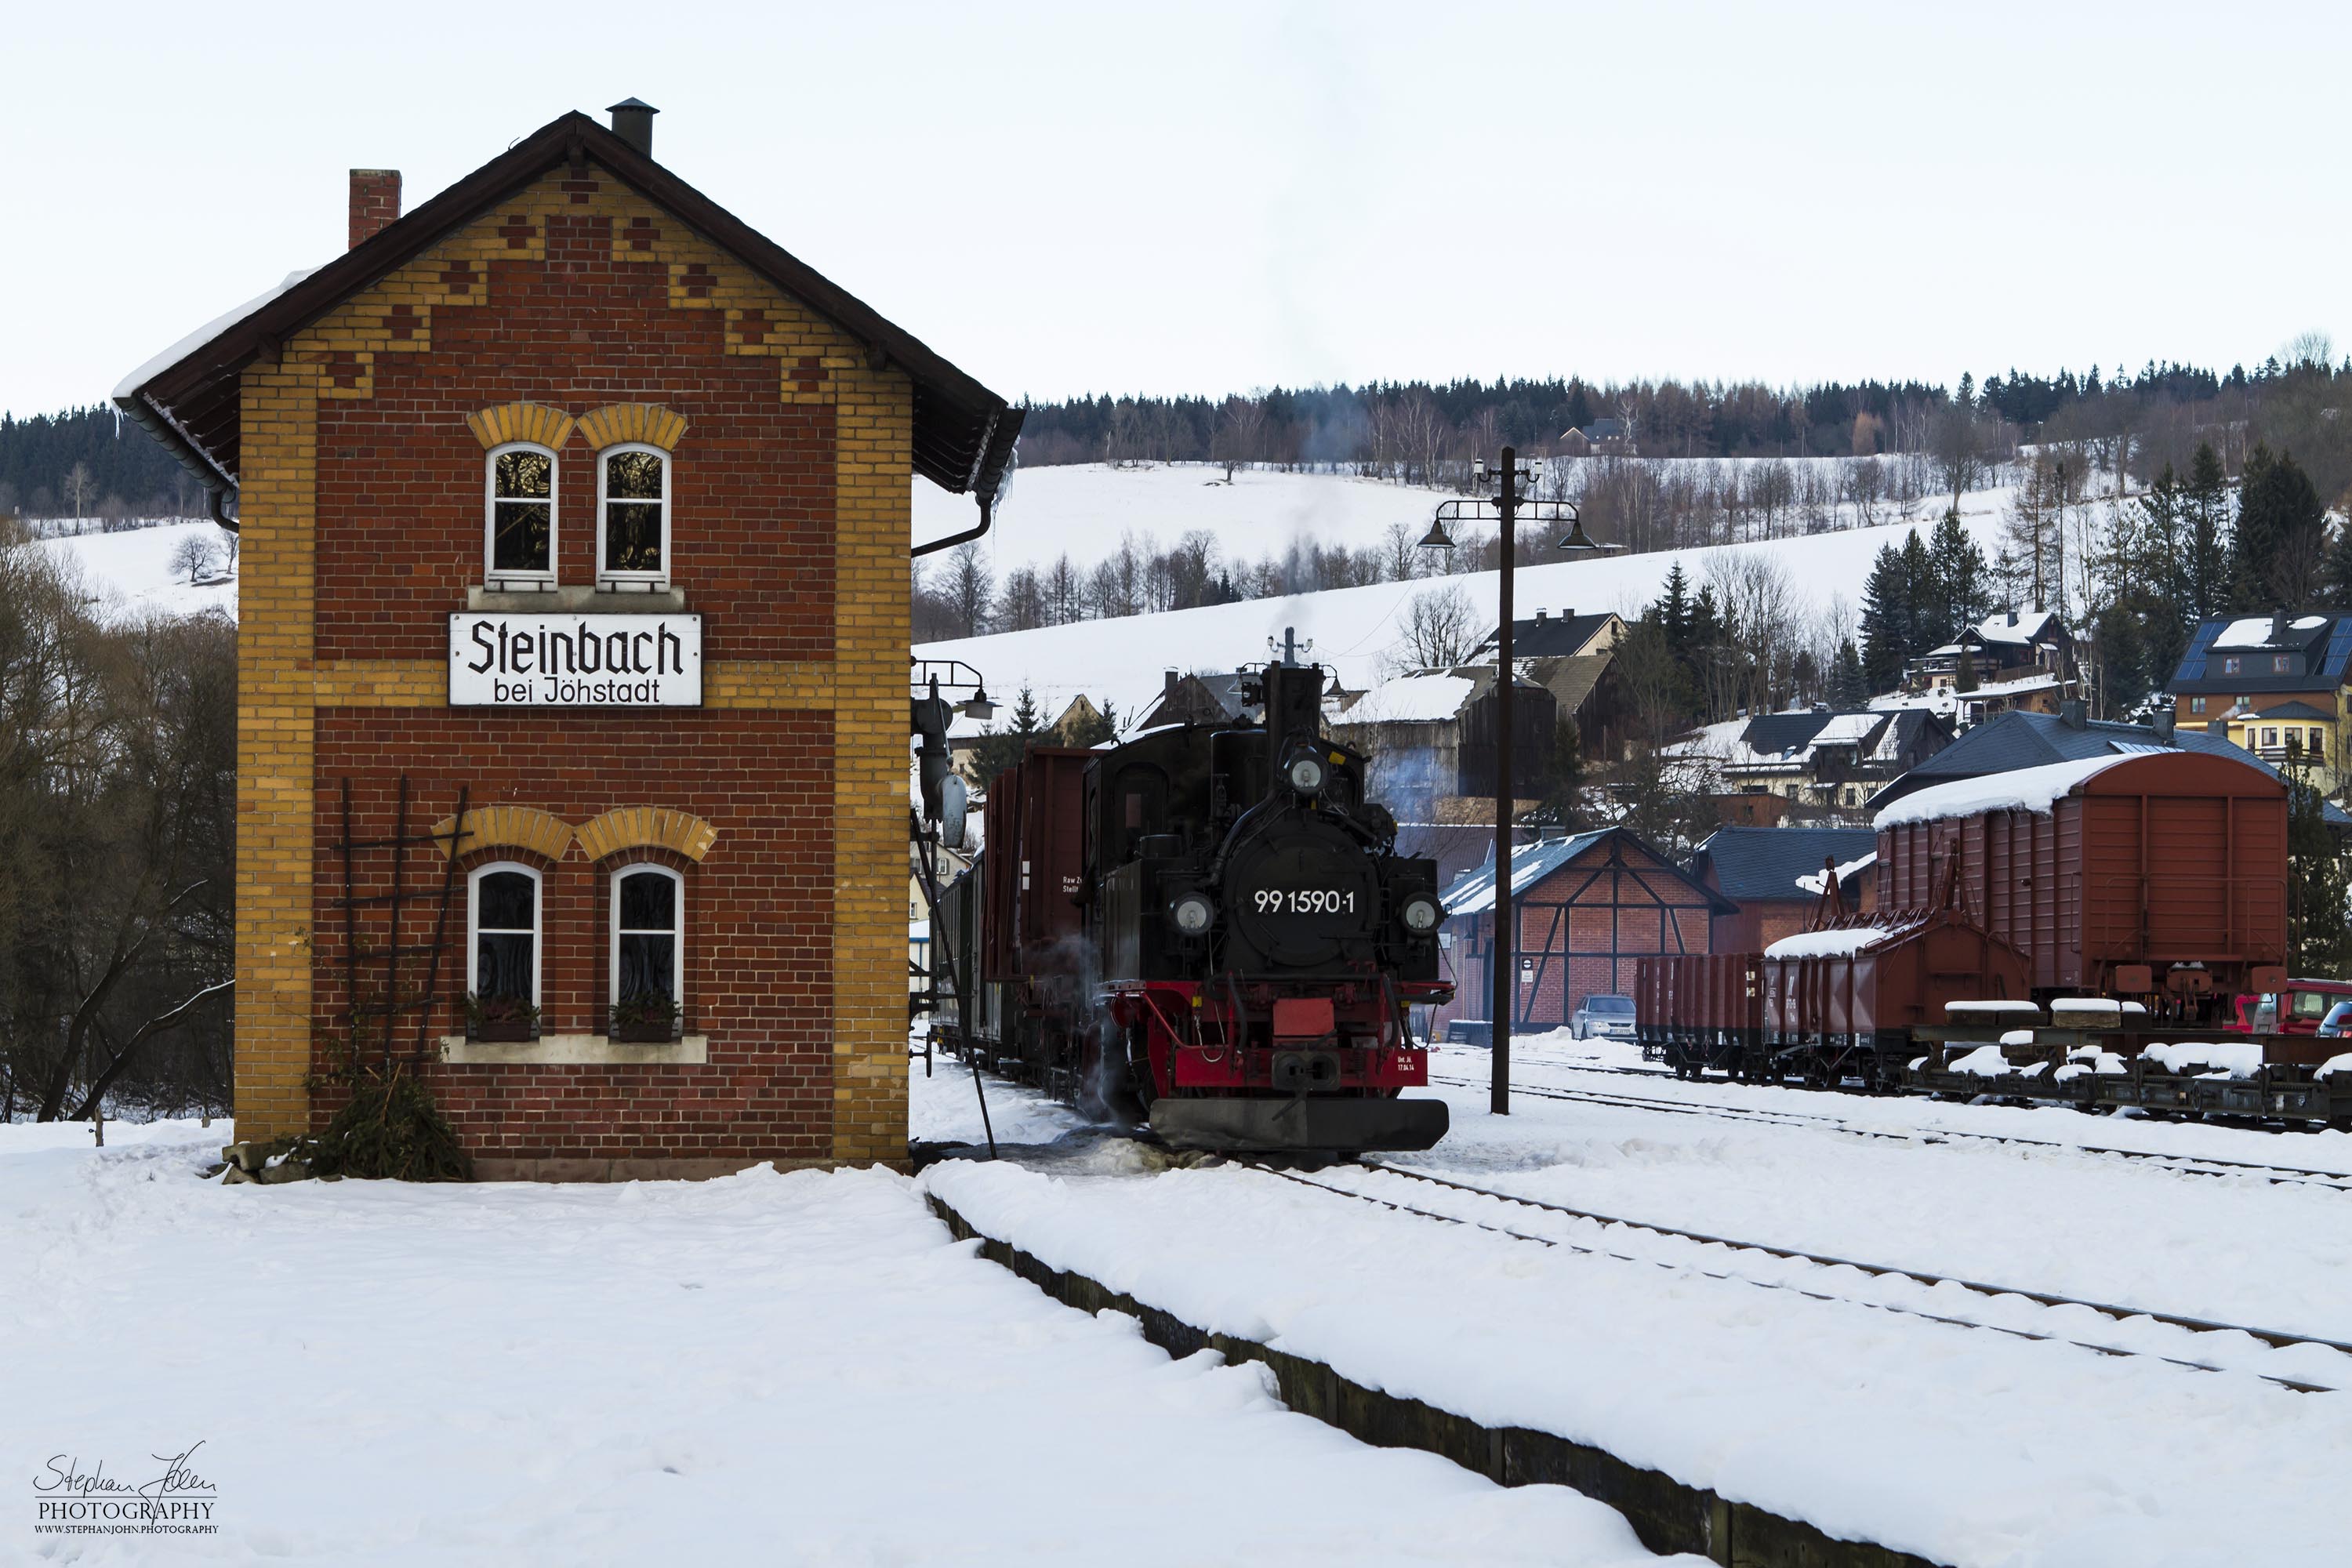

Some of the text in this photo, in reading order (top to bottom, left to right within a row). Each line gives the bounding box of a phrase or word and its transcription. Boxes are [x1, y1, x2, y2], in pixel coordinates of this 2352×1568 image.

[467, 620, 684, 675] Steinbach
[494, 677, 660, 702] bei Jöhstadt
[1254, 890, 1283, 913] 99
